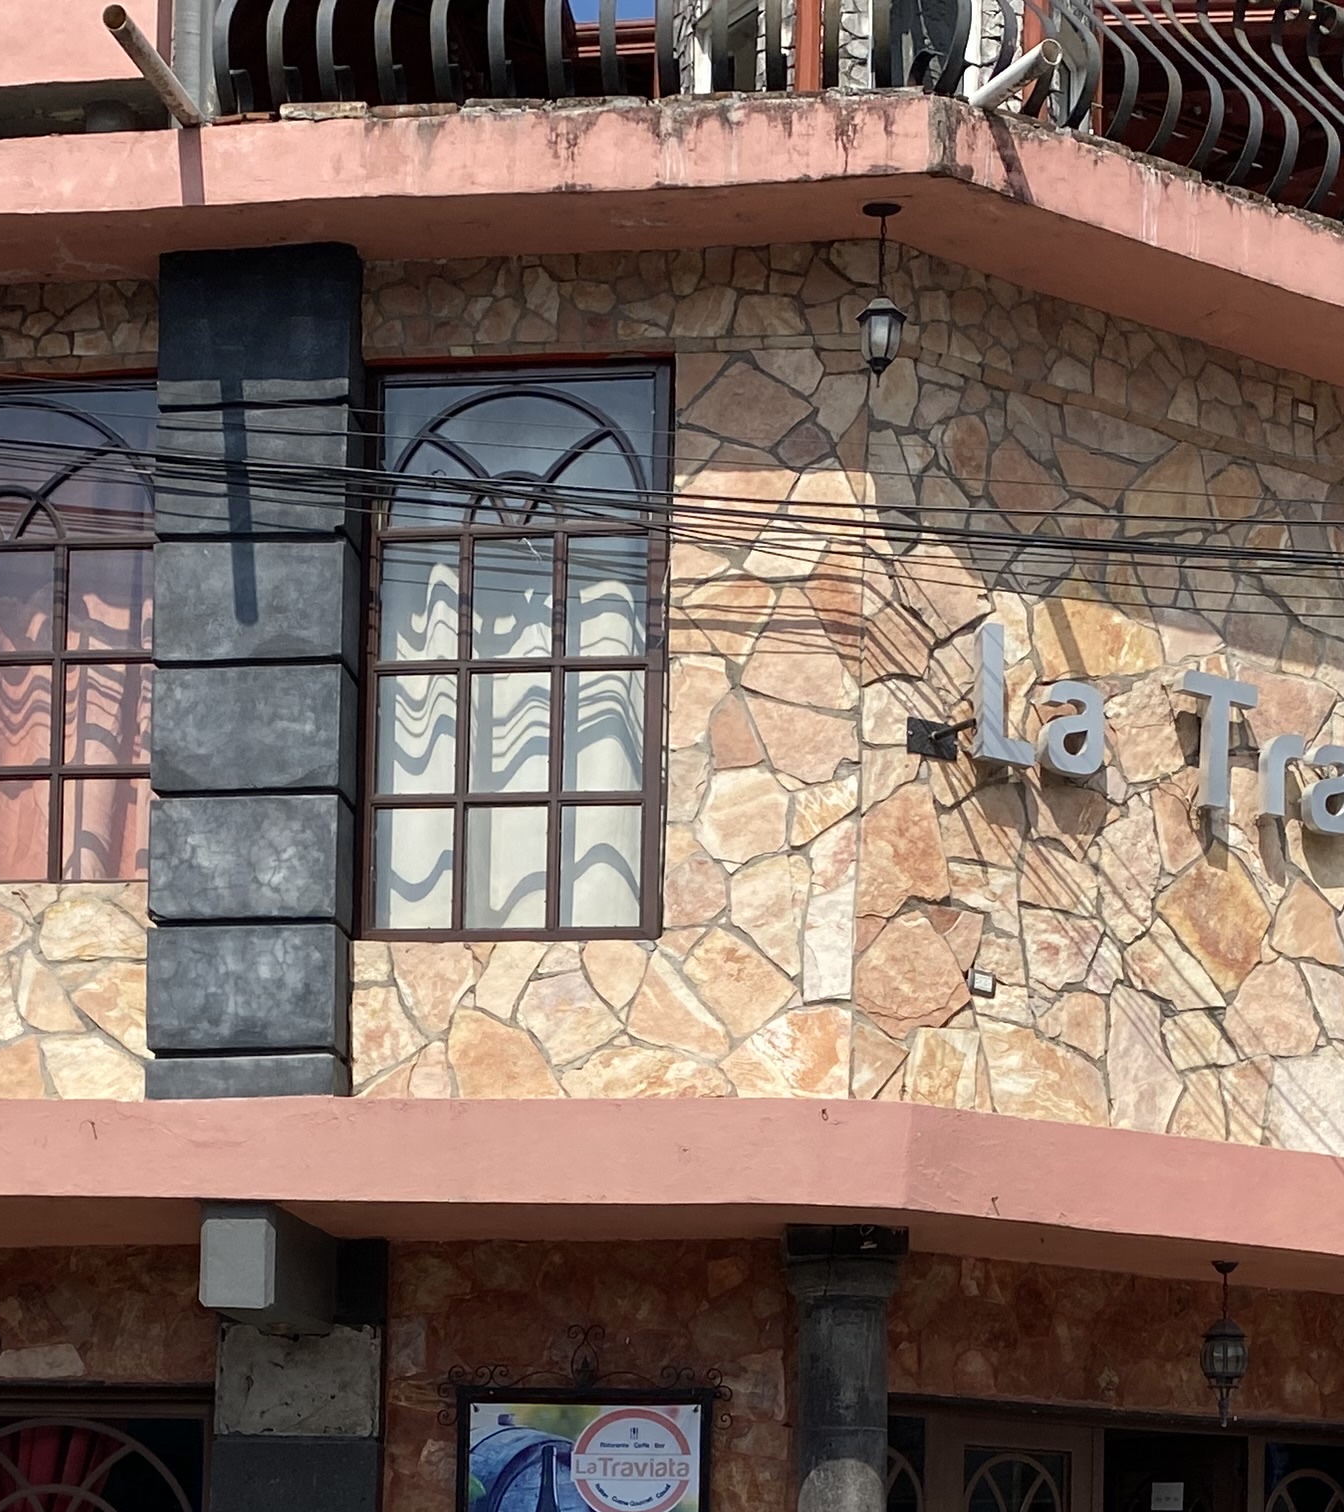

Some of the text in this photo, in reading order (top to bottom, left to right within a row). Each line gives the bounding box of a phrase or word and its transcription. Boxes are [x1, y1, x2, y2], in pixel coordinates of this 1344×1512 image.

[973, 622, 1105, 777] La
[575, 1458, 690, 1477] La Traviata
